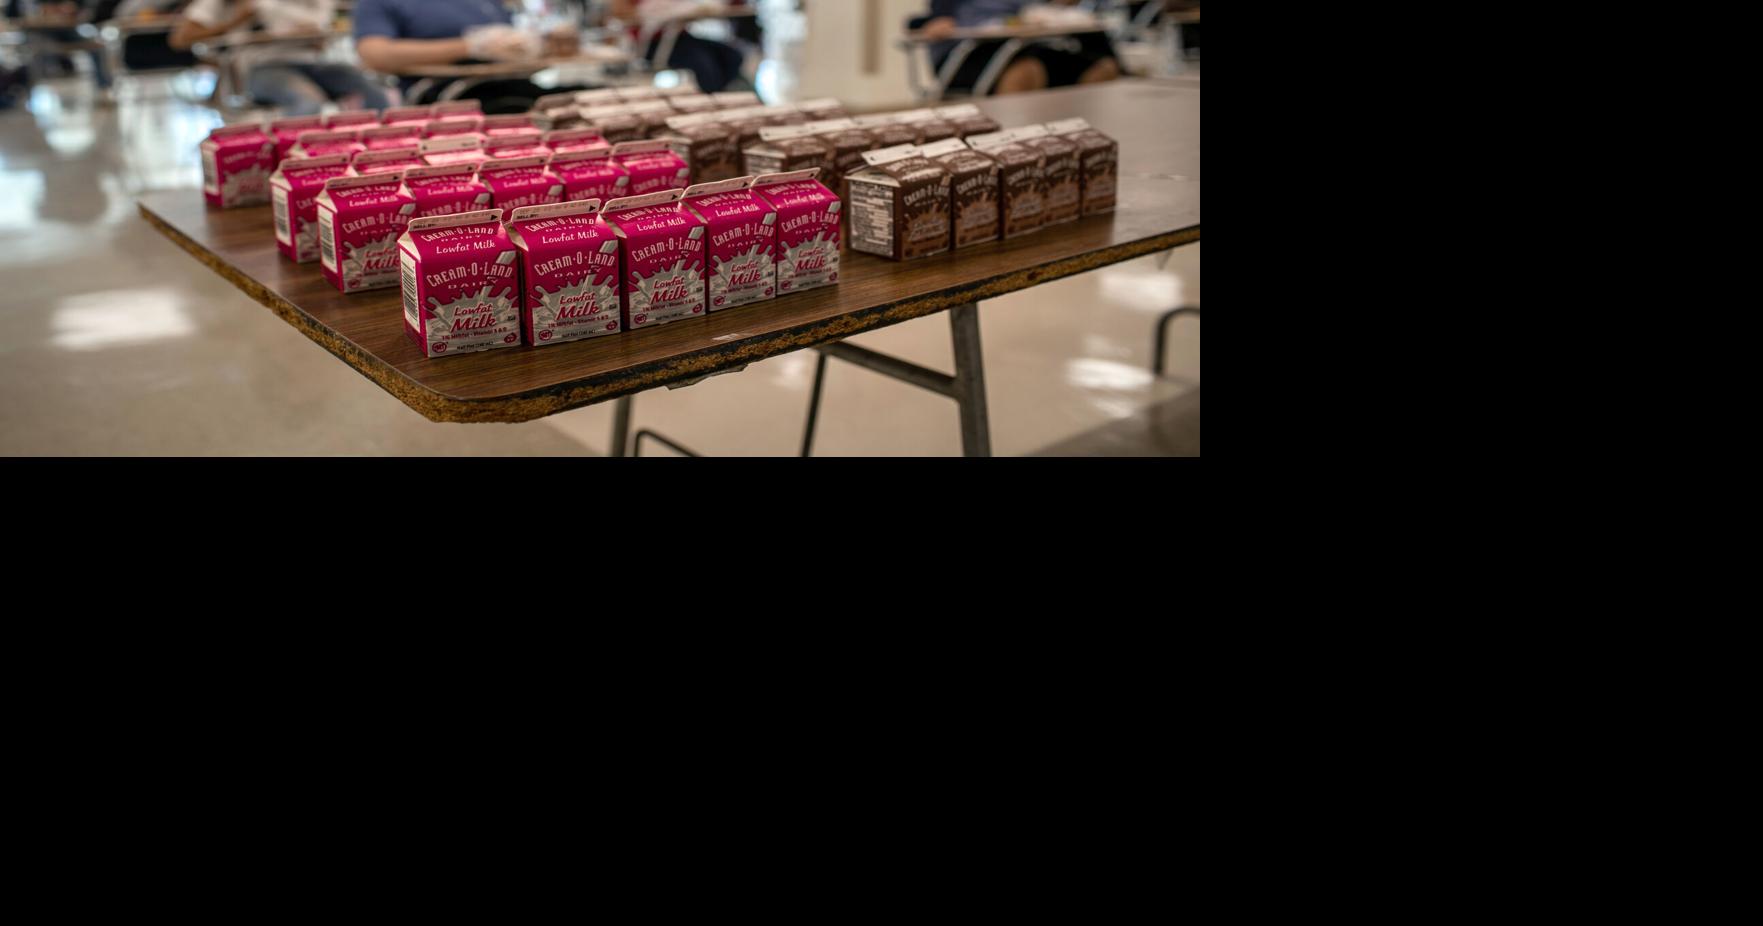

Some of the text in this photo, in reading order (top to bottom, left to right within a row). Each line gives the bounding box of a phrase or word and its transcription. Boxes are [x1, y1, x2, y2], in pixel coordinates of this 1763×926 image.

[637, 217, 686, 231] Lowfat Milk
[542, 229, 599, 244] Lowfat Milk
[436, 240, 496, 254] Lowfat Milk
[653, 276, 685, 289] Lowfat
[727, 269, 761, 288] Milk
[560, 291, 596, 305] Lowfat
[650, 286, 688, 304] Milk
[454, 303, 493, 316] Lowfat
[556, 300, 600, 320] Milk
[450, 313, 497, 333] Milk
